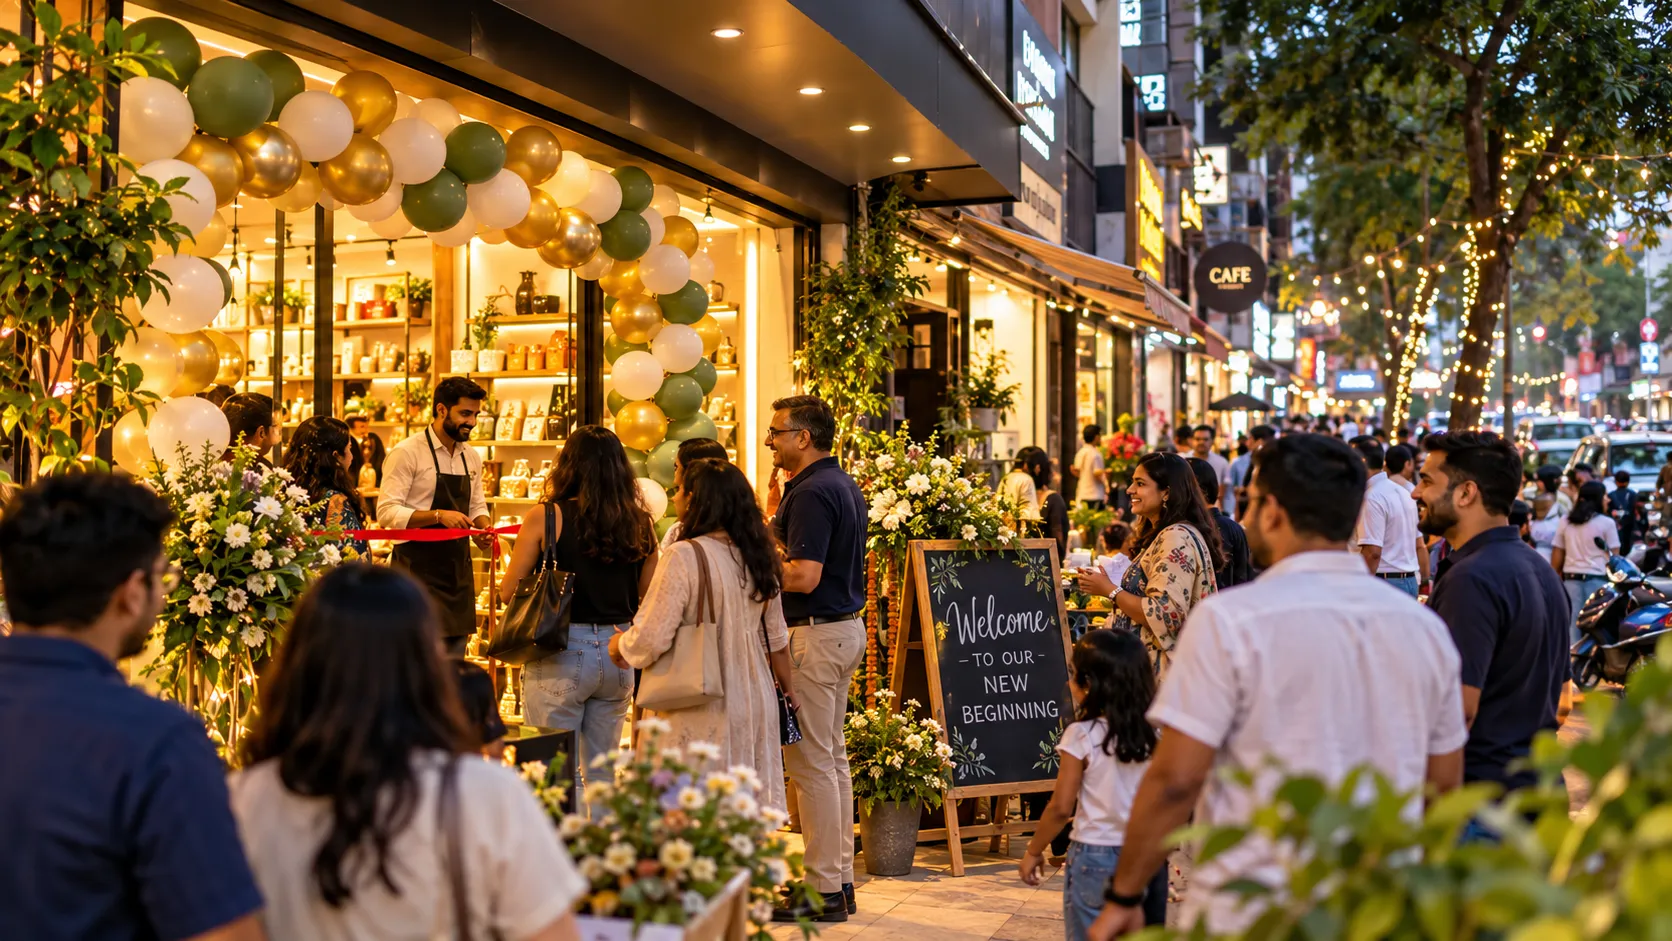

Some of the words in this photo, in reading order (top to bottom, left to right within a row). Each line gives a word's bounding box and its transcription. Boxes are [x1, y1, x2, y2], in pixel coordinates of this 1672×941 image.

[1209, 266, 1252, 284] CAFE
[945, 594, 1049, 645] Welcome
[972, 652, 994, 667] TO
[1001, 650, 1035, 665] OUR
[984, 673, 1028, 694] NEW
[962, 700, 1059, 724] BEGINNING
